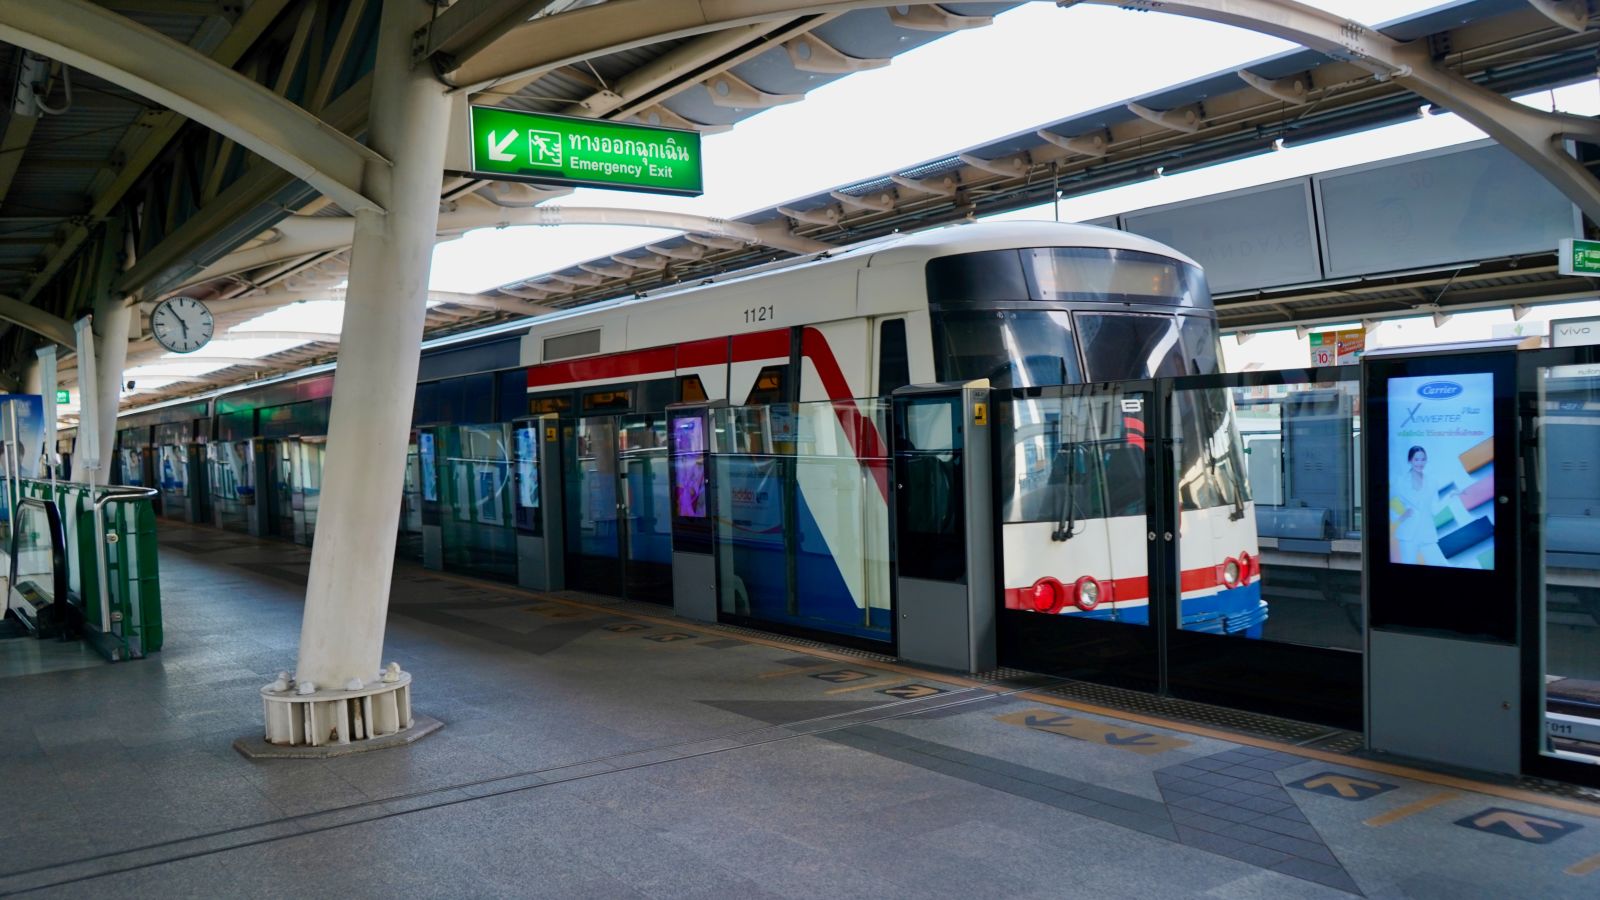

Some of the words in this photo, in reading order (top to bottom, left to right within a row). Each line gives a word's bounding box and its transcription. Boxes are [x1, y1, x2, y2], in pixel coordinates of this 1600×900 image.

[568, 133, 690, 167] ทางออกฉุกเฉิน
[570, 157, 642, 178] Emergency
[649, 163, 673, 179] Exit
[744, 305, 774, 323] 1121
[1560, 327, 1591, 336] vivo
[1317, 353, 1328, 364] 10
[1422, 385, 1457, 396] Carrier
